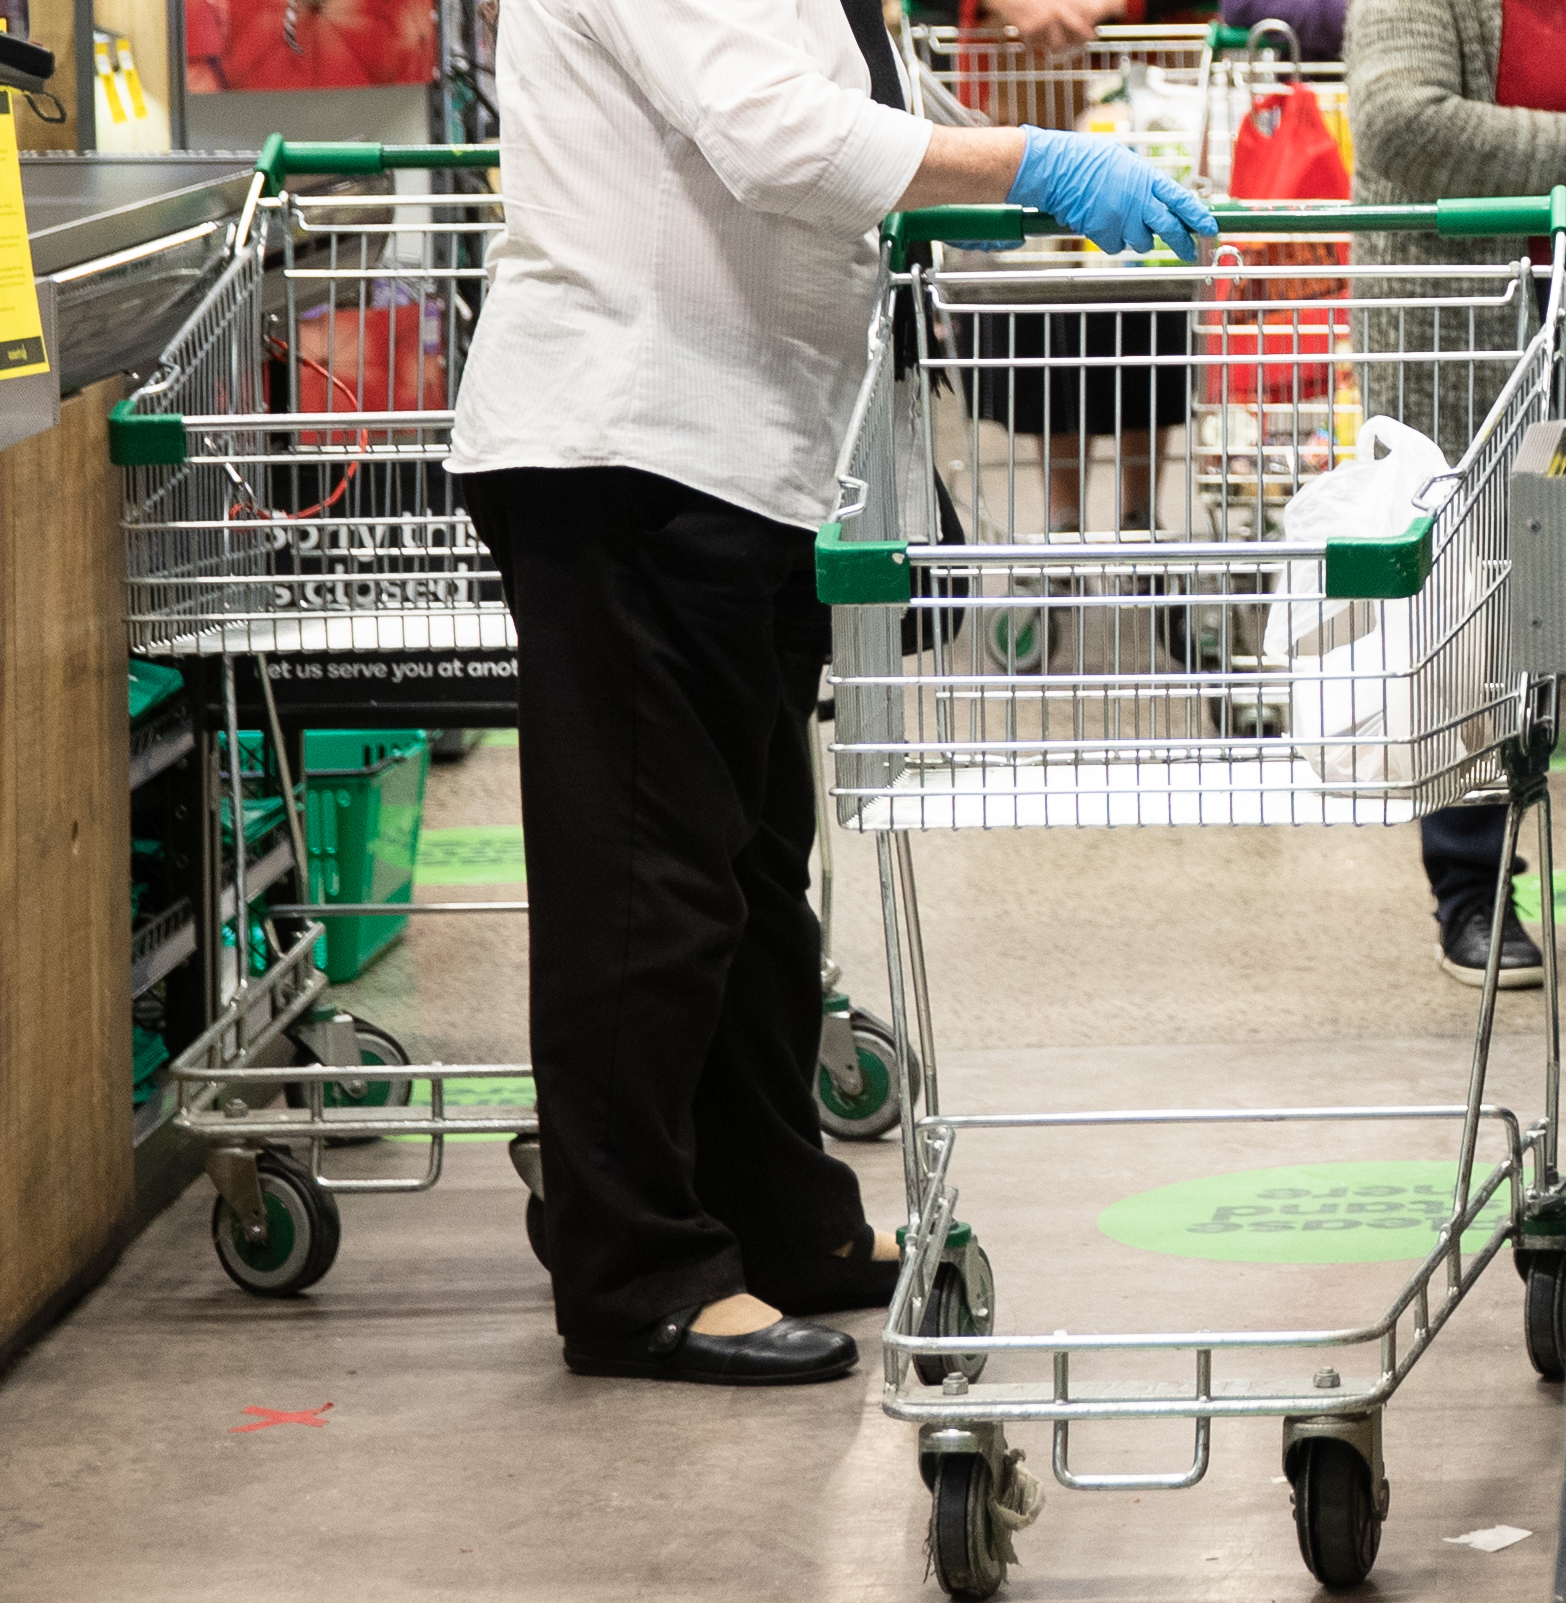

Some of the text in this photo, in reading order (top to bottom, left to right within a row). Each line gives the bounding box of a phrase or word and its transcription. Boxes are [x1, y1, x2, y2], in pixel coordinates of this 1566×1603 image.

[256, 659, 519, 683] et us serve you at anot
